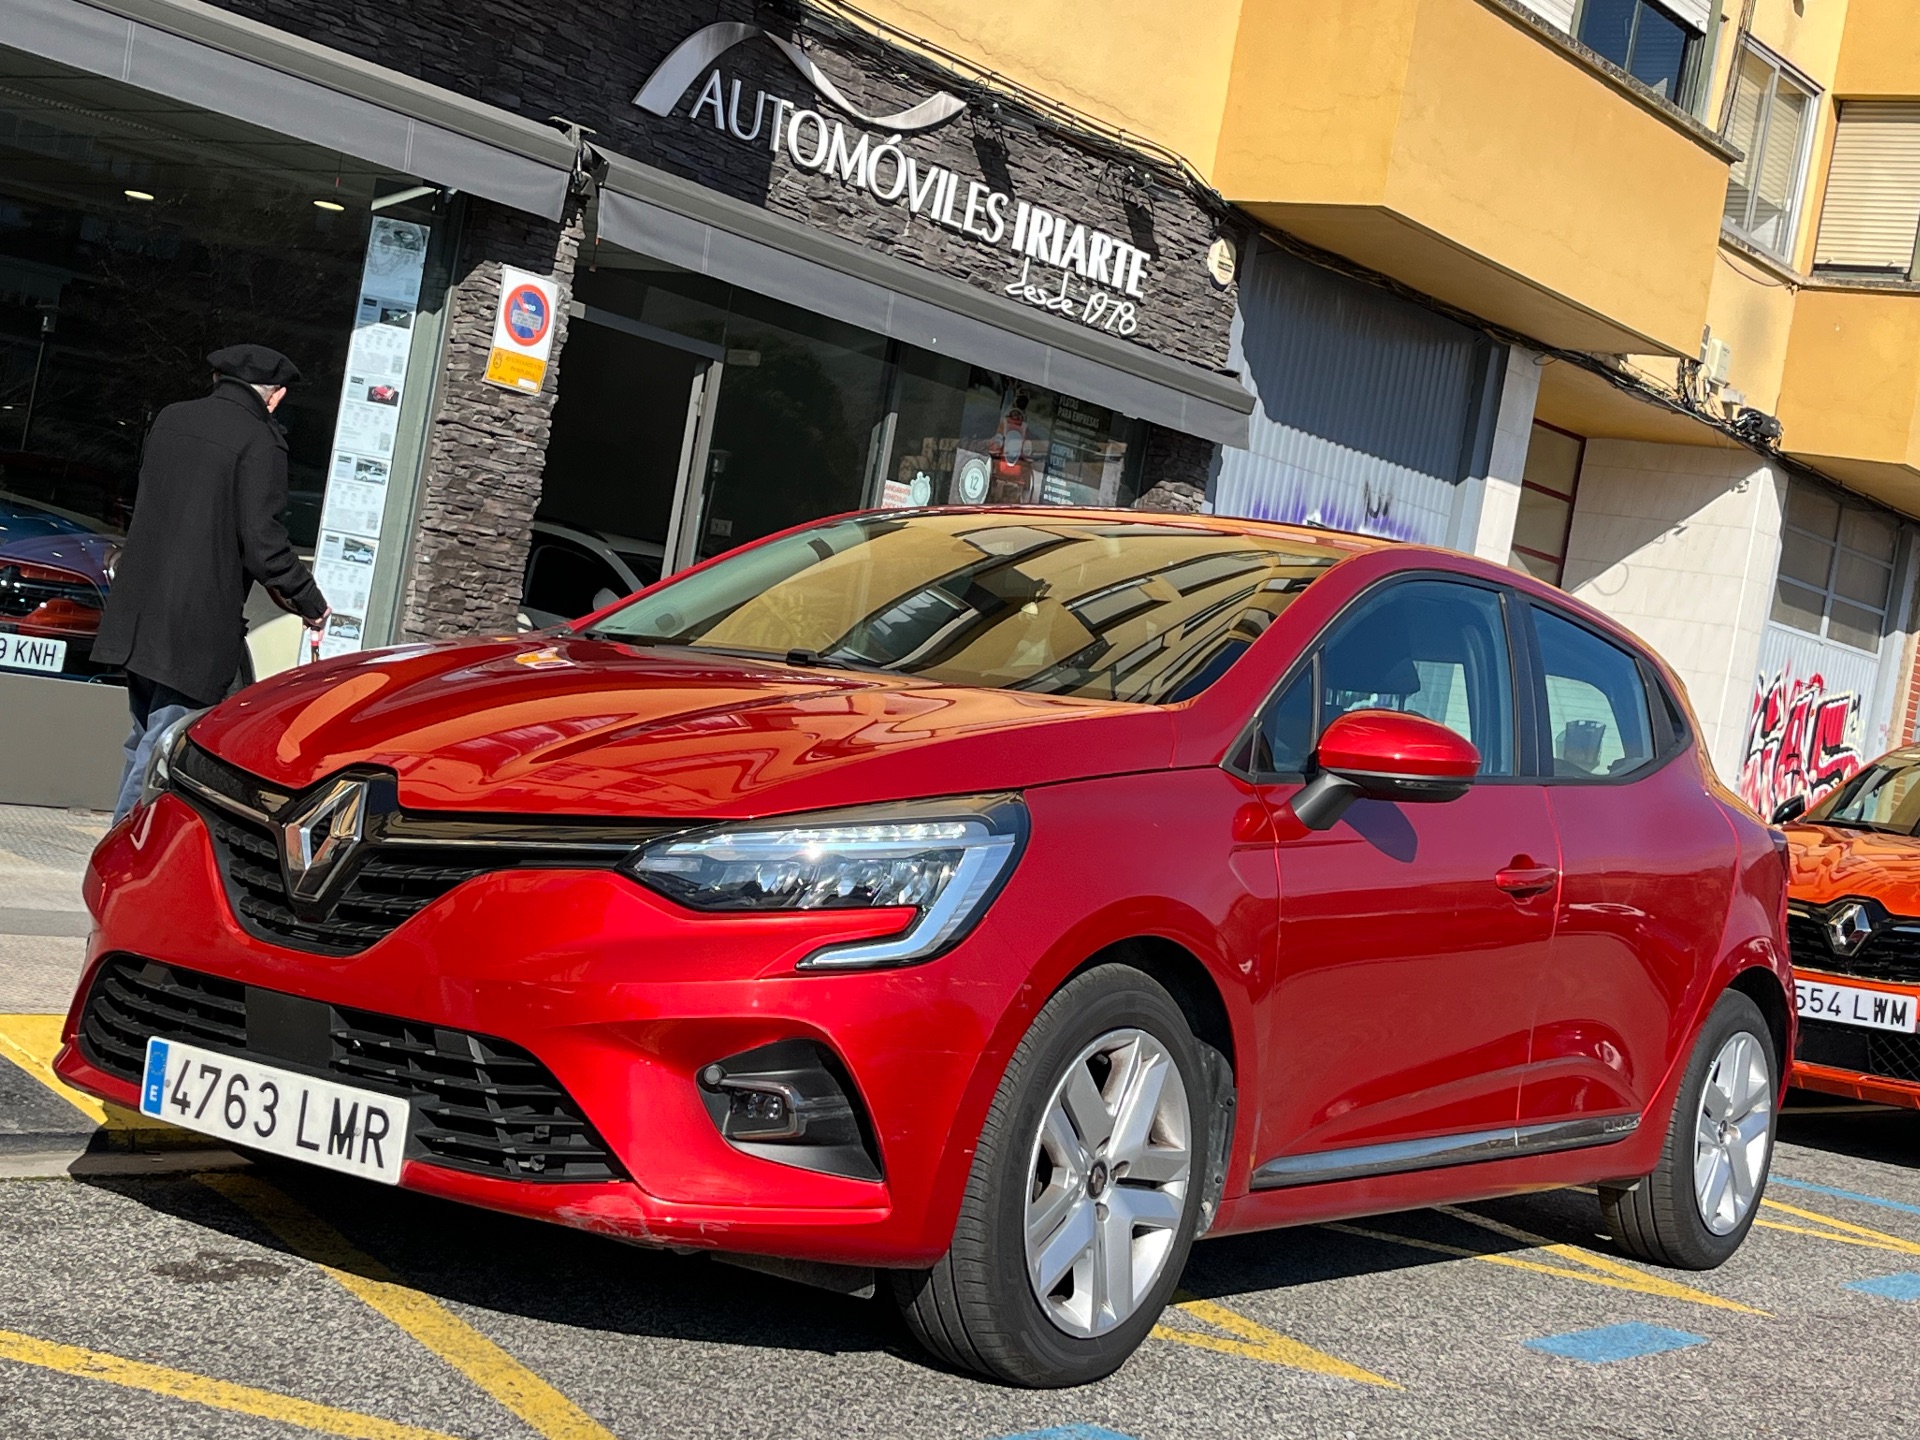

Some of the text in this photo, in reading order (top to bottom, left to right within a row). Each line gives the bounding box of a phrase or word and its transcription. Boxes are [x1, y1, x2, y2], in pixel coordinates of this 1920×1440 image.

[689, 69, 1151, 299] AUTOMÓVILES IRIARTE
[1004, 257, 1137, 335] desde 1978
[970, 475, 980, 491] 12
[14, 640, 57, 667] KNH
[1853, 995, 1907, 1027] LWM
[149, 1085, 159, 1102] E
[170, 1059, 390, 1169] 4763 LMR
